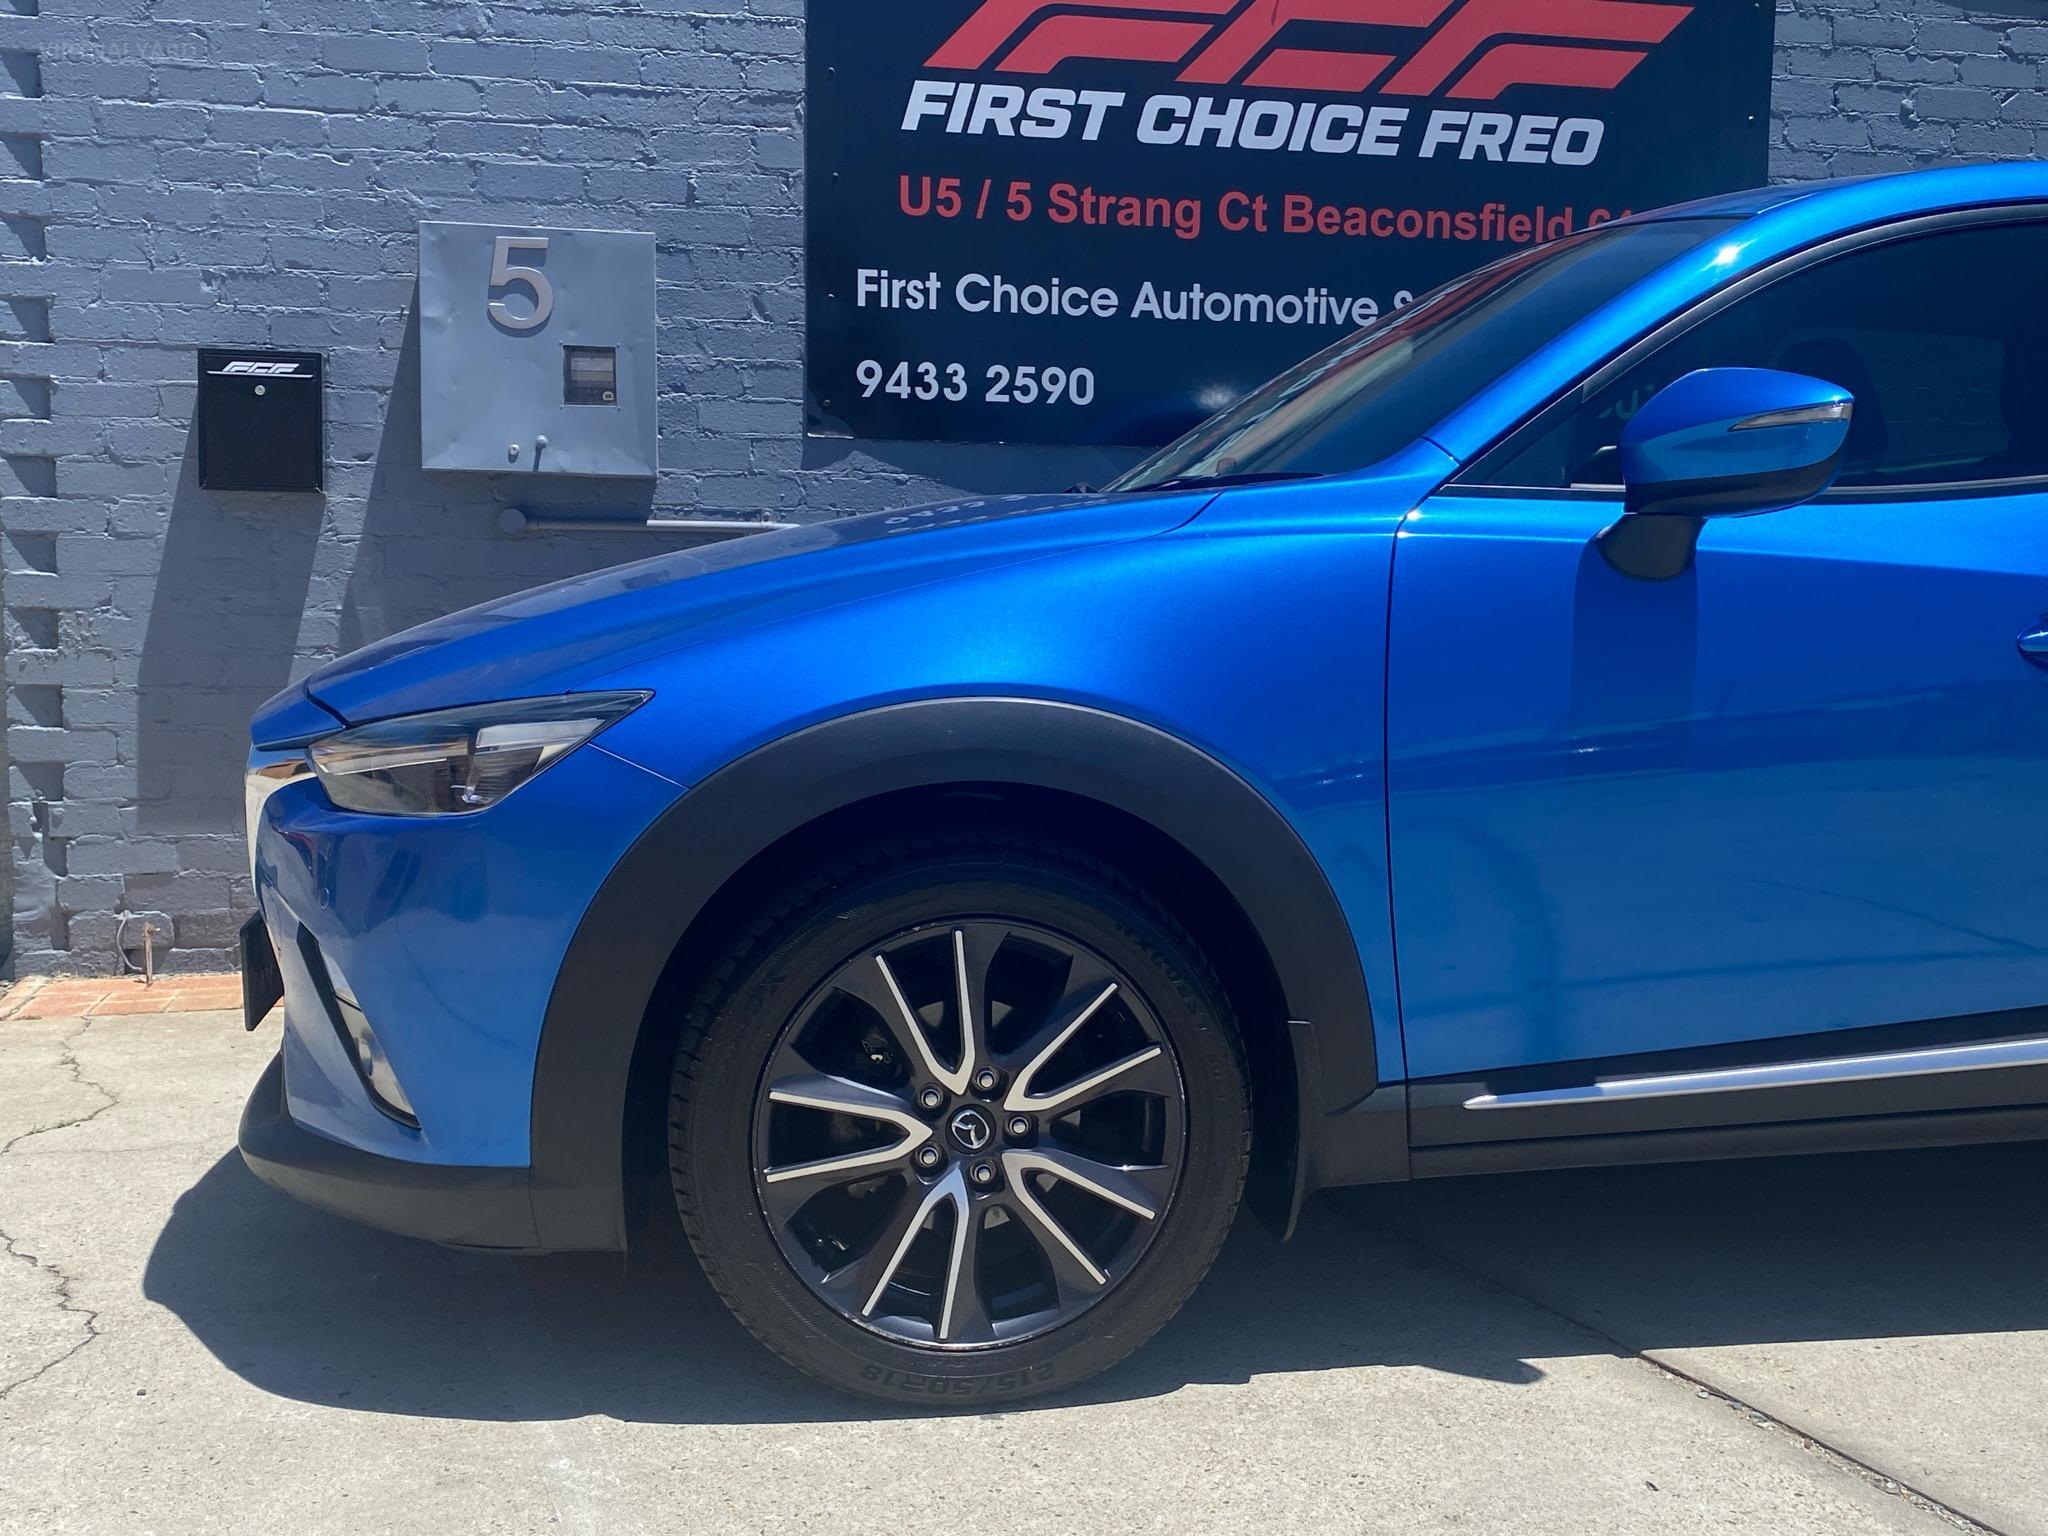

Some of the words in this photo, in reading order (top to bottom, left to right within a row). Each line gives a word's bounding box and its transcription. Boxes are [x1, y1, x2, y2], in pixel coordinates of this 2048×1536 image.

[901, 80, 1126, 140] FIRST
[1137, 94, 1409, 156] CHOICE
[1418, 110, 1605, 166] FREO
[900, 175, 962, 219] U5
[976, 179, 991, 220] /
[1006, 181, 1032, 222] 5
[1048, 182, 1201, 239] Strang
[1218, 191, 1267, 233] Ct
[1283, 193, 1573, 243] Beaconsfield
[487, 235, 553, 330] 5
[856, 268, 941, 310] First
[956, 273, 1119, 318] Choice
[1131, 281, 1378, 326] Automotive
[856, 360, 968, 401] 9433
[985, 364, 1095, 406] 2590
[860, 1361, 1056, 1396] 215/50R18
